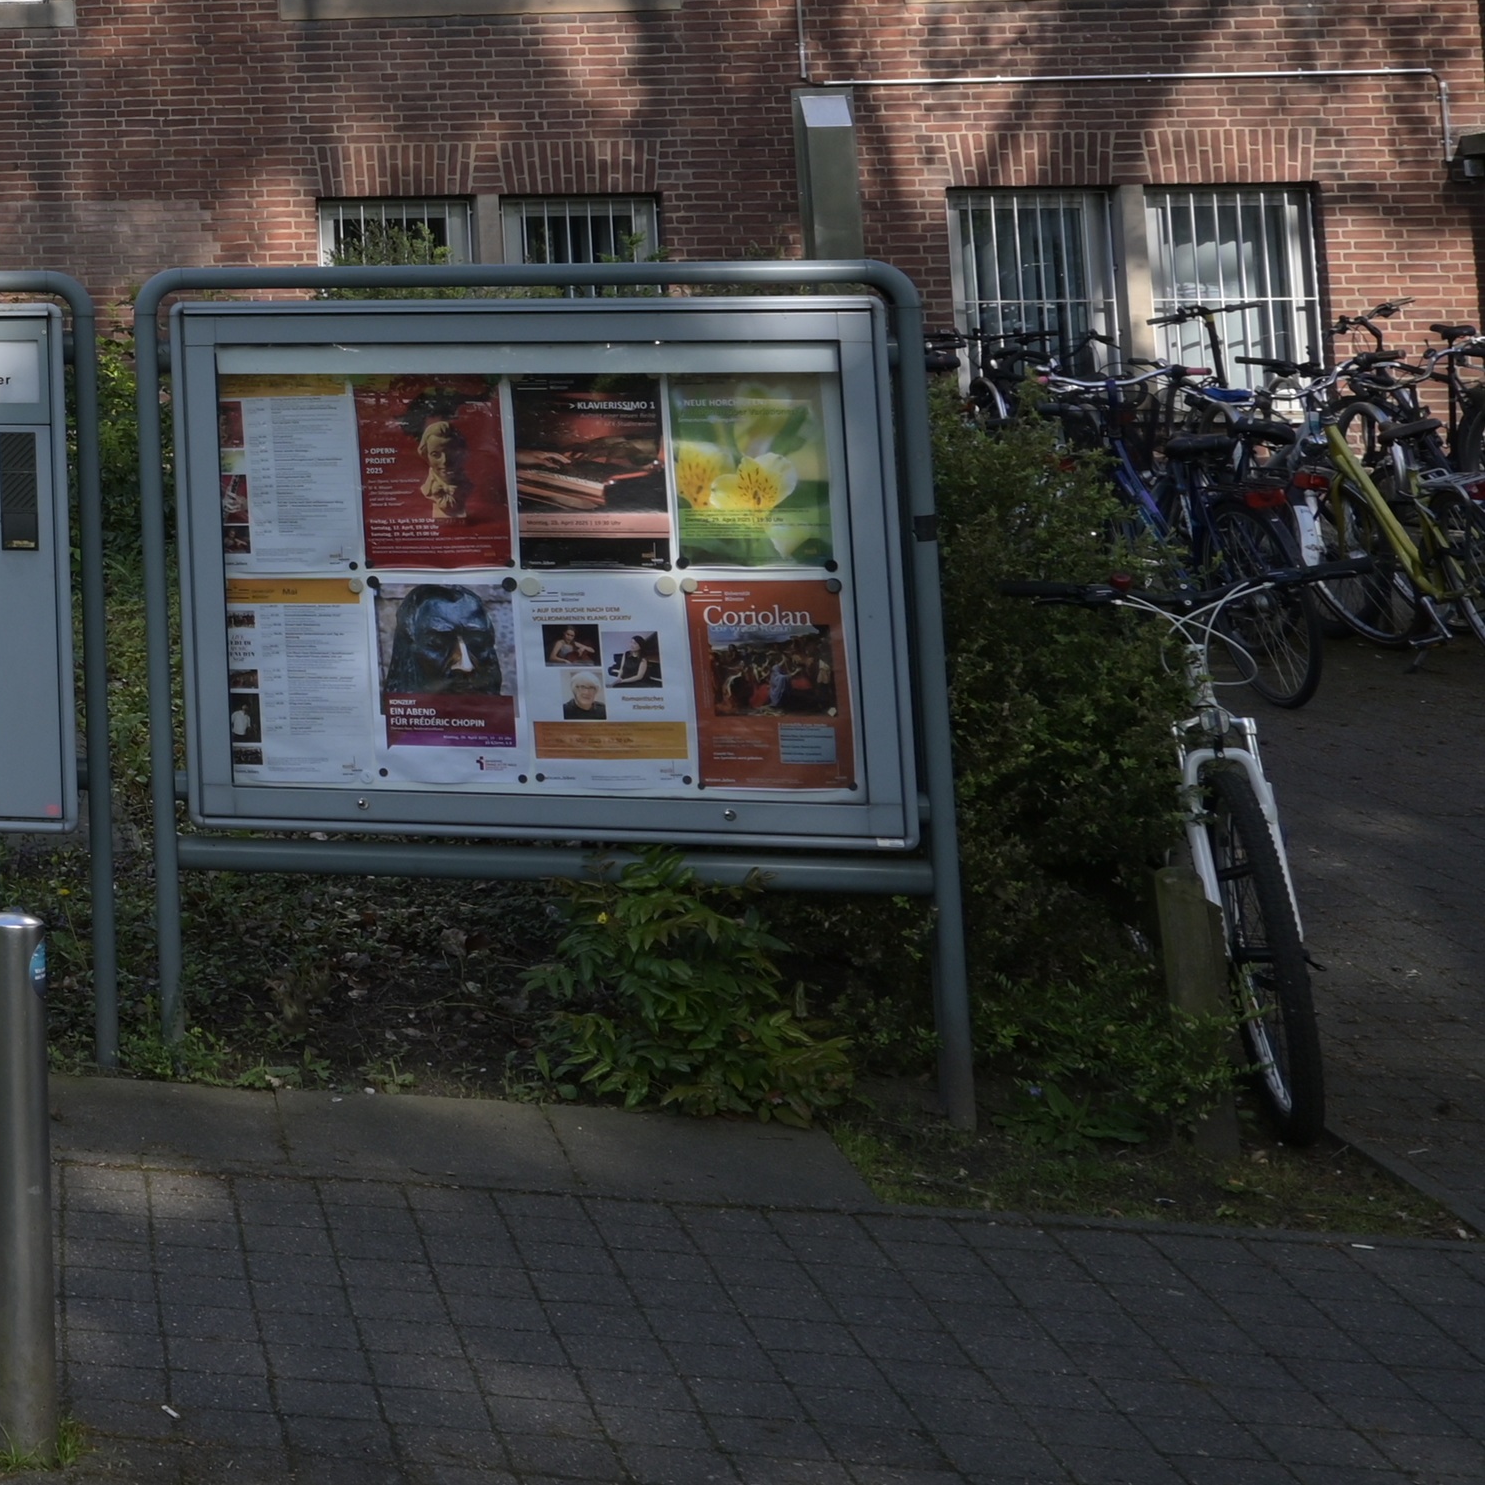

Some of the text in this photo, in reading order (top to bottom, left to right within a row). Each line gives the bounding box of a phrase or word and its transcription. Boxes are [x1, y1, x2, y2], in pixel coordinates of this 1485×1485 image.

[577, 400, 656, 410] KLAVIERISSIMO 1
[683, 398, 706, 407] NEUE
[370, 447, 398, 455] OPERN-
[366, 467, 384, 475] 2025
[282, 588, 298, 596] Mai
[703, 603, 812, 626] Coriolan
[389, 707, 437, 716] EIN ABEND
[390, 716, 485, 727] FÜR FRÉDÉRIC CHOPIN
